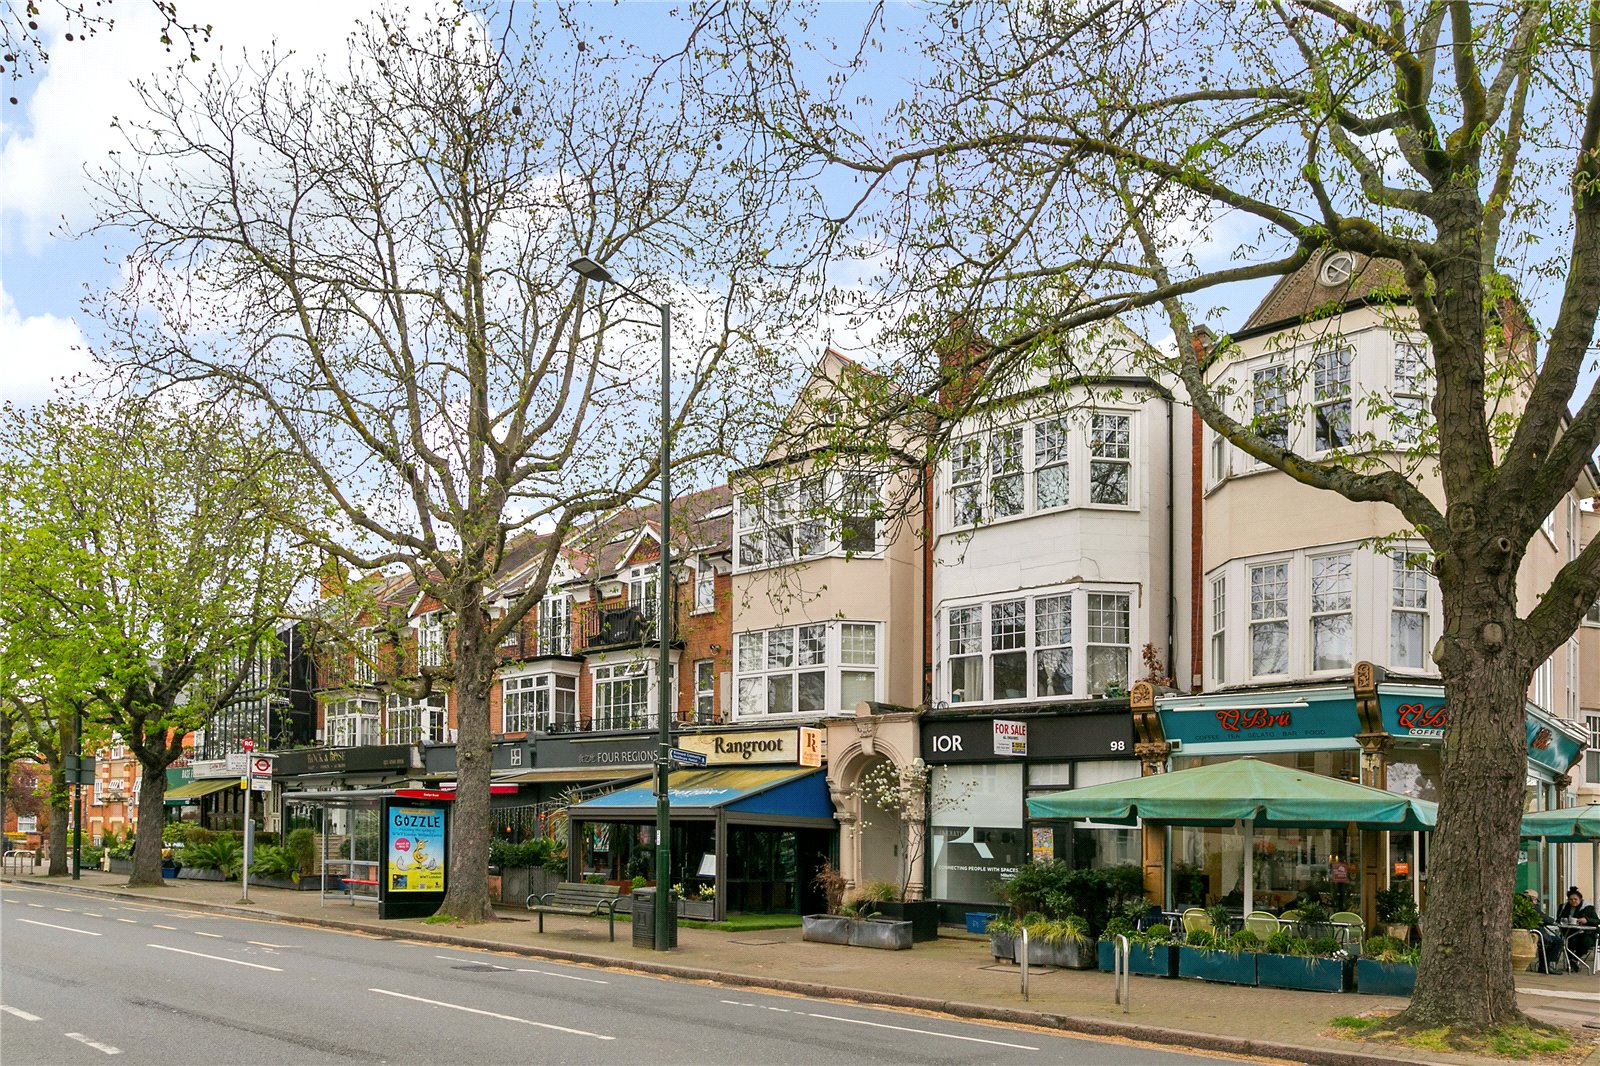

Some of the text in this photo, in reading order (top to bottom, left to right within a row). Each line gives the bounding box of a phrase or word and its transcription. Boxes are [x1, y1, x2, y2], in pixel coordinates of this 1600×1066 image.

[995, 723, 1026, 736] FOR SALE
[714, 736, 784, 759] Rangroot
[933, 735, 963, 752] IOR
[1110, 740, 1125, 751] 98
[597, 751, 620, 763] FOUR
[622, 750, 659, 762] REGIONS
[394, 814, 441, 828] GOZZLE
